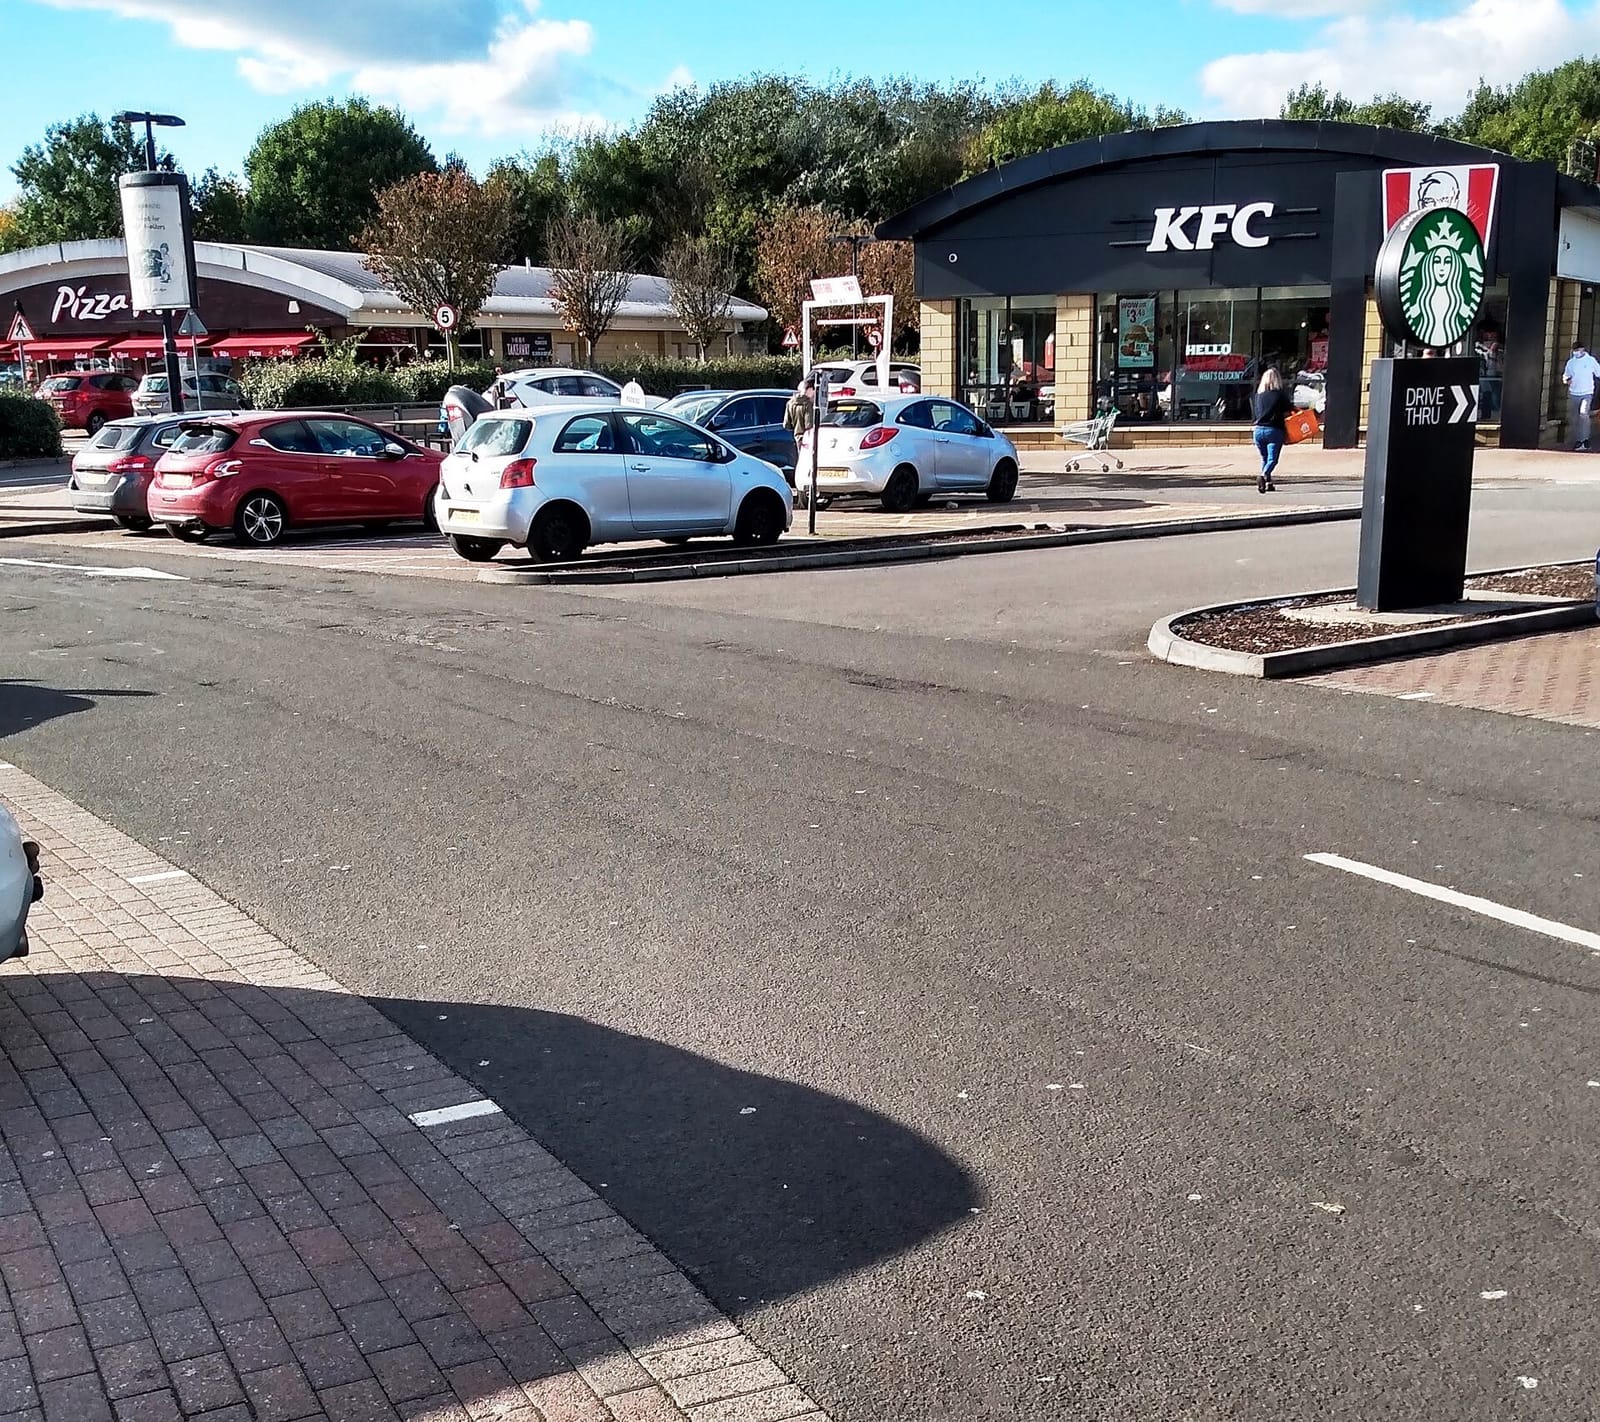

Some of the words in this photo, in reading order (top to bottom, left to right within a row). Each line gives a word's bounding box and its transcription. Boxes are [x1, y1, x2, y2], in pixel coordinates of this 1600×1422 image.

[1146, 202, 1274, 252] KFC
[51, 286, 128, 323] Pizza
[441, 310, 449, 324] 5
[1186, 344, 1231, 356] HELLO
[1406, 386, 1445, 406] DRIVE
[1405, 406, 1441, 426] THRU
